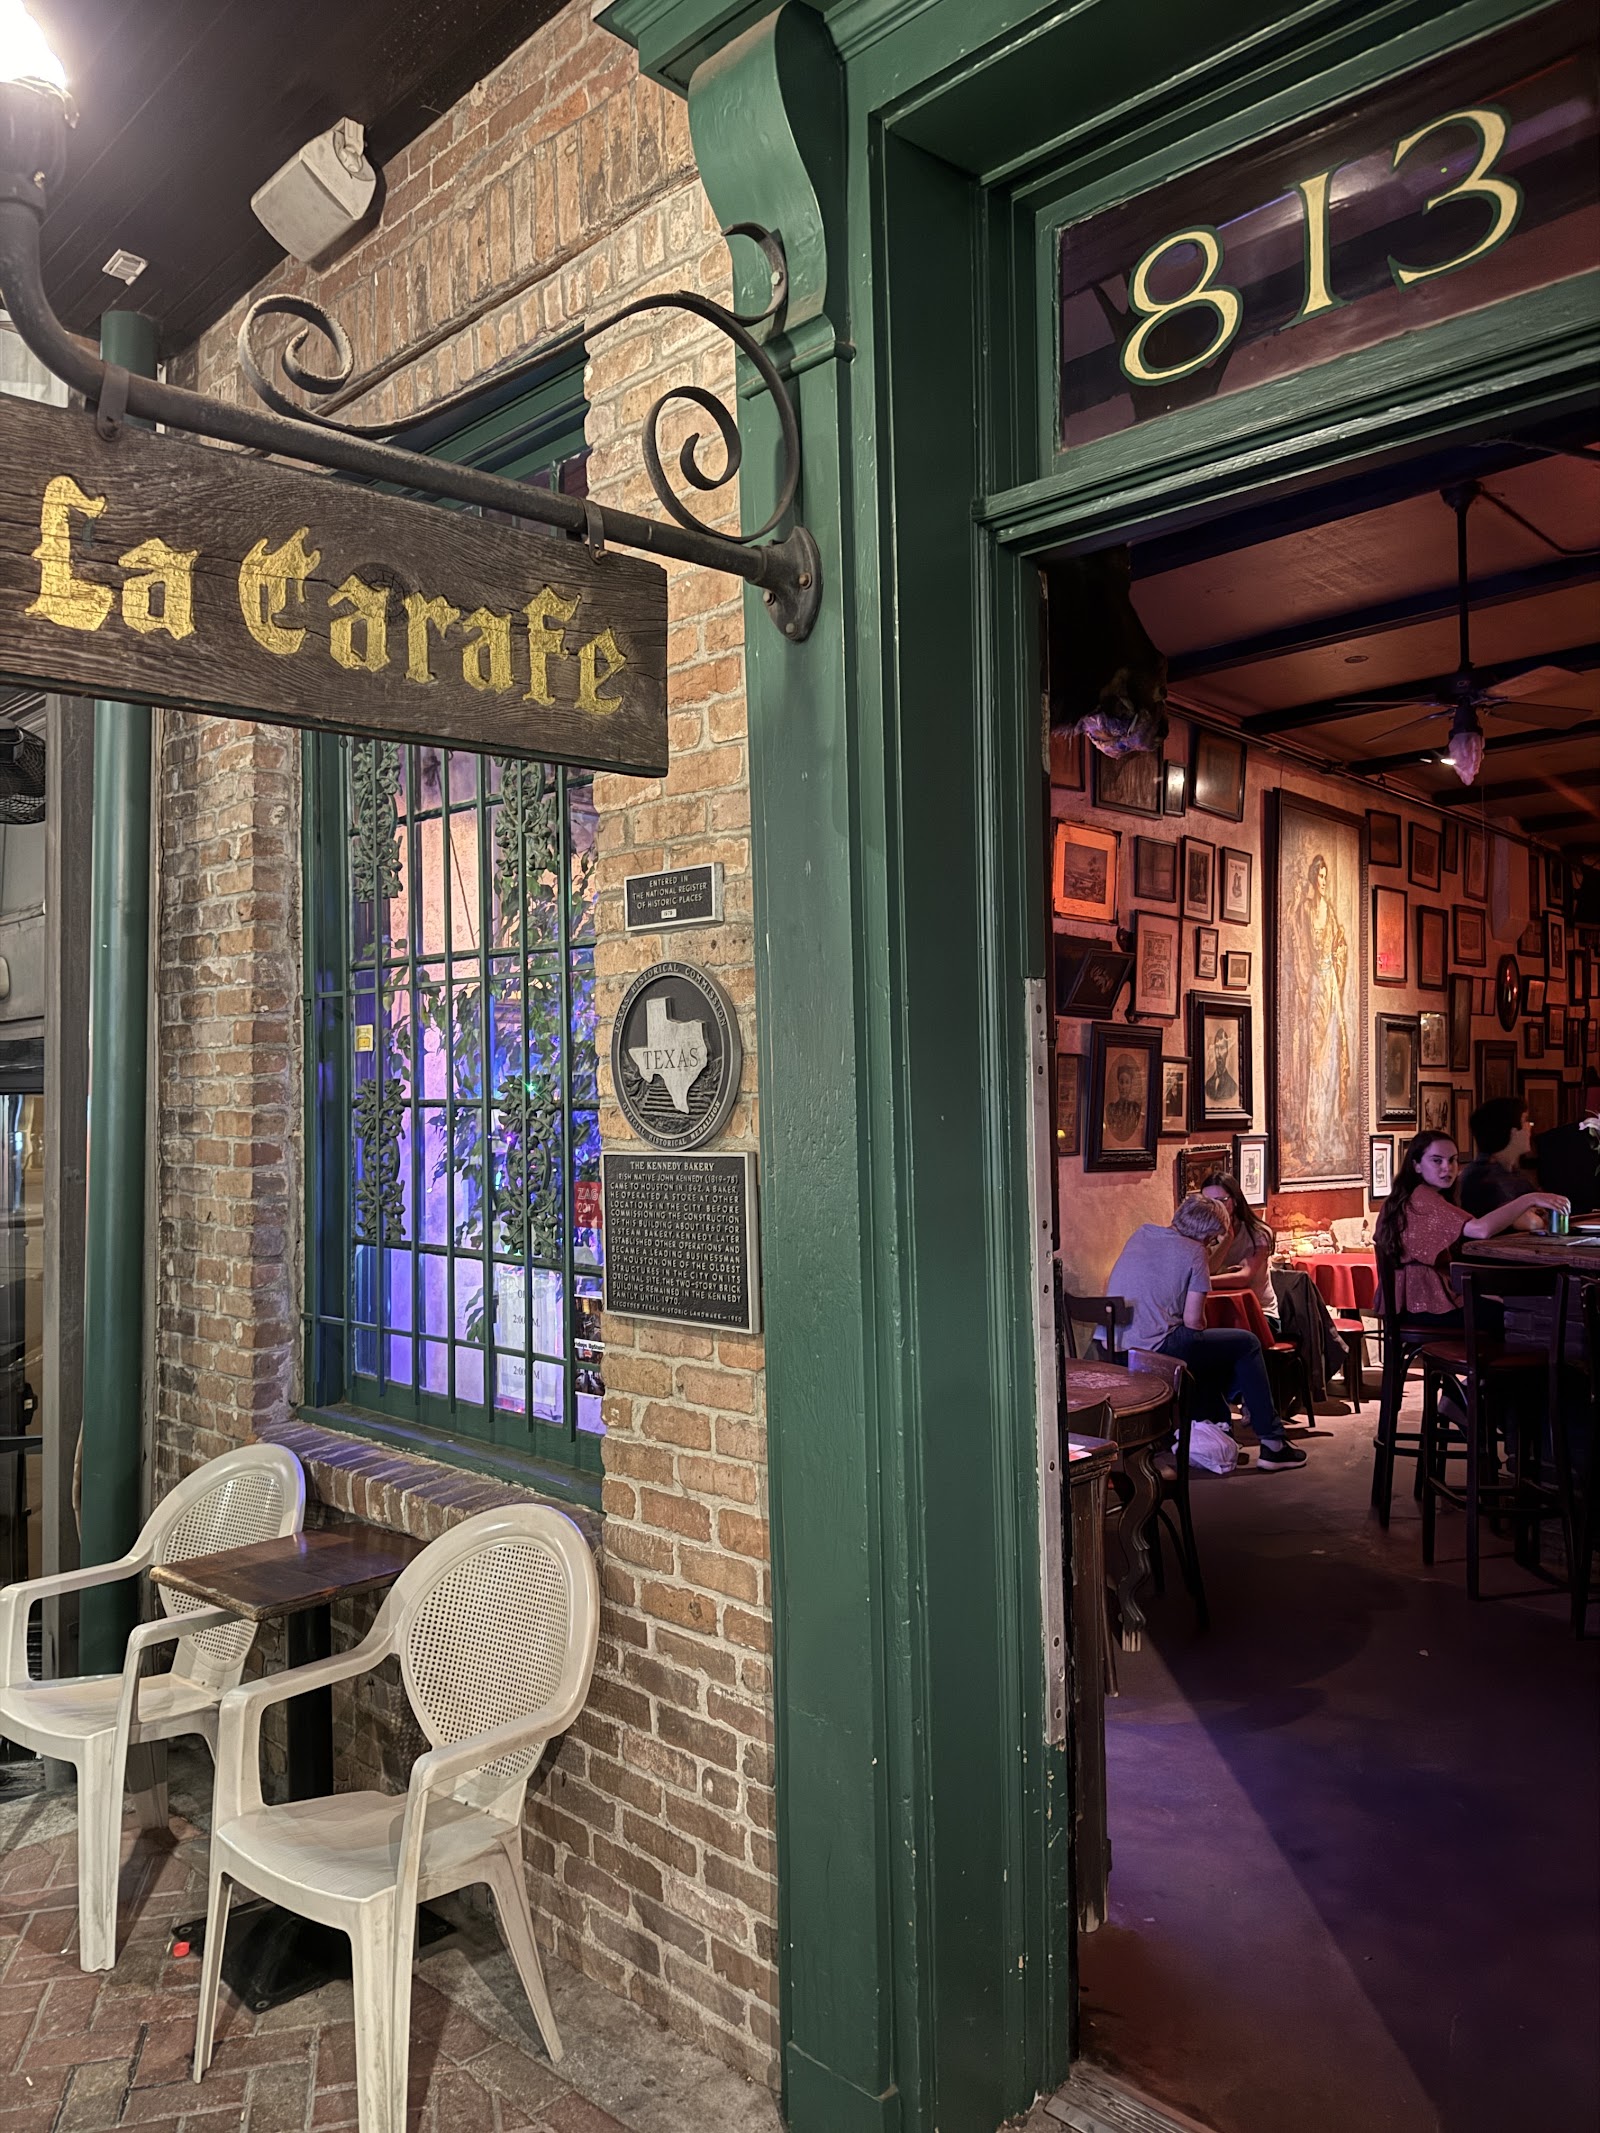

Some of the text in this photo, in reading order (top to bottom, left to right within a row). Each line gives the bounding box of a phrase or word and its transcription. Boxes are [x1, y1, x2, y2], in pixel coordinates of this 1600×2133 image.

[1121, 106, 1522, 384] 813
[24, 475, 629, 717] La Carafe
[649, 876, 678, 888] ENTERED
[632, 882, 708, 900] THE NATIONAL REGISTER
[636, 893, 703, 910] OF HISTORIC PLACES
[614, 963, 728, 1034] TEXAS HISTORICAL COMMISSION
[642, 1047, 699, 1070] TEXAS
[622, 1100, 721, 1147] OFFICIAL HISTORICAL MEDALLION
[630, 1161, 716, 1172] THE KENNEDY BAKERY
[617, 1172, 632, 1180] IRISH
[634, 1174, 656, 1182] NATIVE
[657, 1174, 674, 1182] JOHN
[676, 1174, 704, 1183] KENNEDY
[610, 1182, 628, 1190] CAME
[630, 1182, 639, 1190] TO
[640, 1182, 674, 1191] HOUSTON
[675, 1184, 683, 1192] IN
[705, 1185, 710, 1193] A
[610, 1190, 739, 1204] HE OPERATED A STORE AT OTHER
[610, 1200, 654, 1210] LOCATIONS
[666, 1202, 680, 1211] THE
[684, 1204, 702, 1212] CITY
[706, 1204, 740, 1214] BEFORE
[610, 1208, 740, 1224] COMMISSIONING THE CONSTRUCTION
[611, 1218, 740, 1234] OF THIS BUILDING ABOUT 1860 FOR
[618, 1228, 641, 1236] STEAM
[676, 1232, 713, 1241] KENNEDY
[716, 1234, 740, 1244] LATER
[612, 1236, 740, 1254] ESTABLISHED OTHER OPERATIONS AND
[612, 1245, 640, 1255] BECAME
[650, 1248, 683, 1259] LEADING
[686, 1252, 740, 1264] BUSINESSMAN
[612, 1254, 621, 1262] OF
[662, 1258, 676, 1268] ONE
[680, 1260, 690, 1268] OF
[692, 1261, 706, 1270] THE
[709, 1263, 740, 1274] OLDEST
[612, 1264, 660, 1276] STRUCTURES
[674, 1270, 688, 1278] THE
[690, 1272, 709, 1281] CITY
[712, 1273, 724, 1282] ON
[727, 1275, 741, 1284] ITS
[612, 1272, 644, 1282] ORIGINAL
[662, 1278, 674, 1286] THE
[676, 1280, 716, 1290] TWO-STORY
[720, 1284, 741, 1294] BRICK
[612, 1282, 742, 1303] BUILDING REMAINED IN THE KENNEDY
[613, 1290, 681, 1306] FAMILY UNTIL 1970.
[642, 1304, 660, 1312] TEXAS
[662, 1307, 688, 1316] HISTORIC
